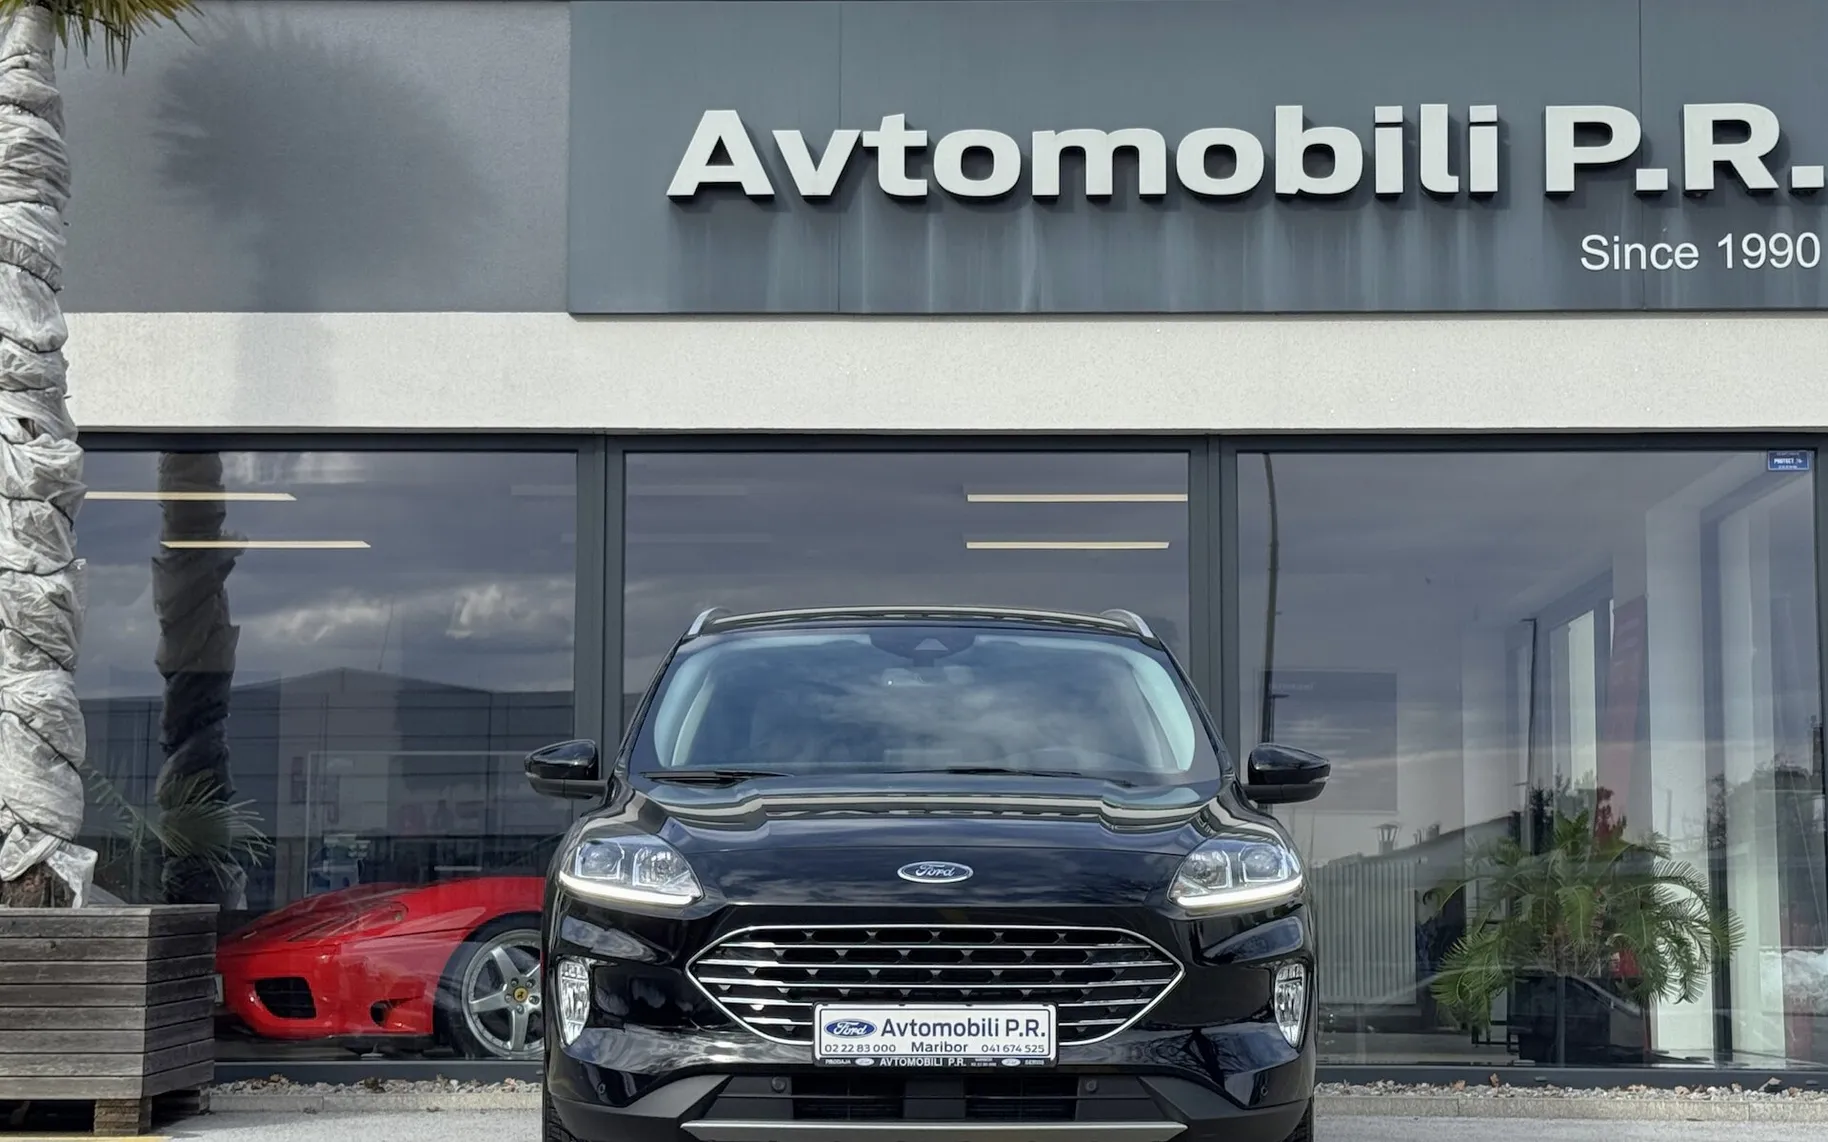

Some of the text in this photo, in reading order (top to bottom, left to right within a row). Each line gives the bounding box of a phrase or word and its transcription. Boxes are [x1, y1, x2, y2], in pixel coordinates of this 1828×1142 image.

[666, 102, 1825, 198] Avtomobili P.R.
[1580, 231, 1822, 270] Since 1990
[830, 1018, 1046, 1037] Ford Avtomobili P.R.
[825, 1044, 896, 1053] 02 22 83 000
[911, 1041, 969, 1053] Maribor
[981, 1044, 1045, 1053] 041 674 525
[880, 1057, 943, 1067] AVTOMOBILI
[948, 1057, 967, 1067] P.R.
